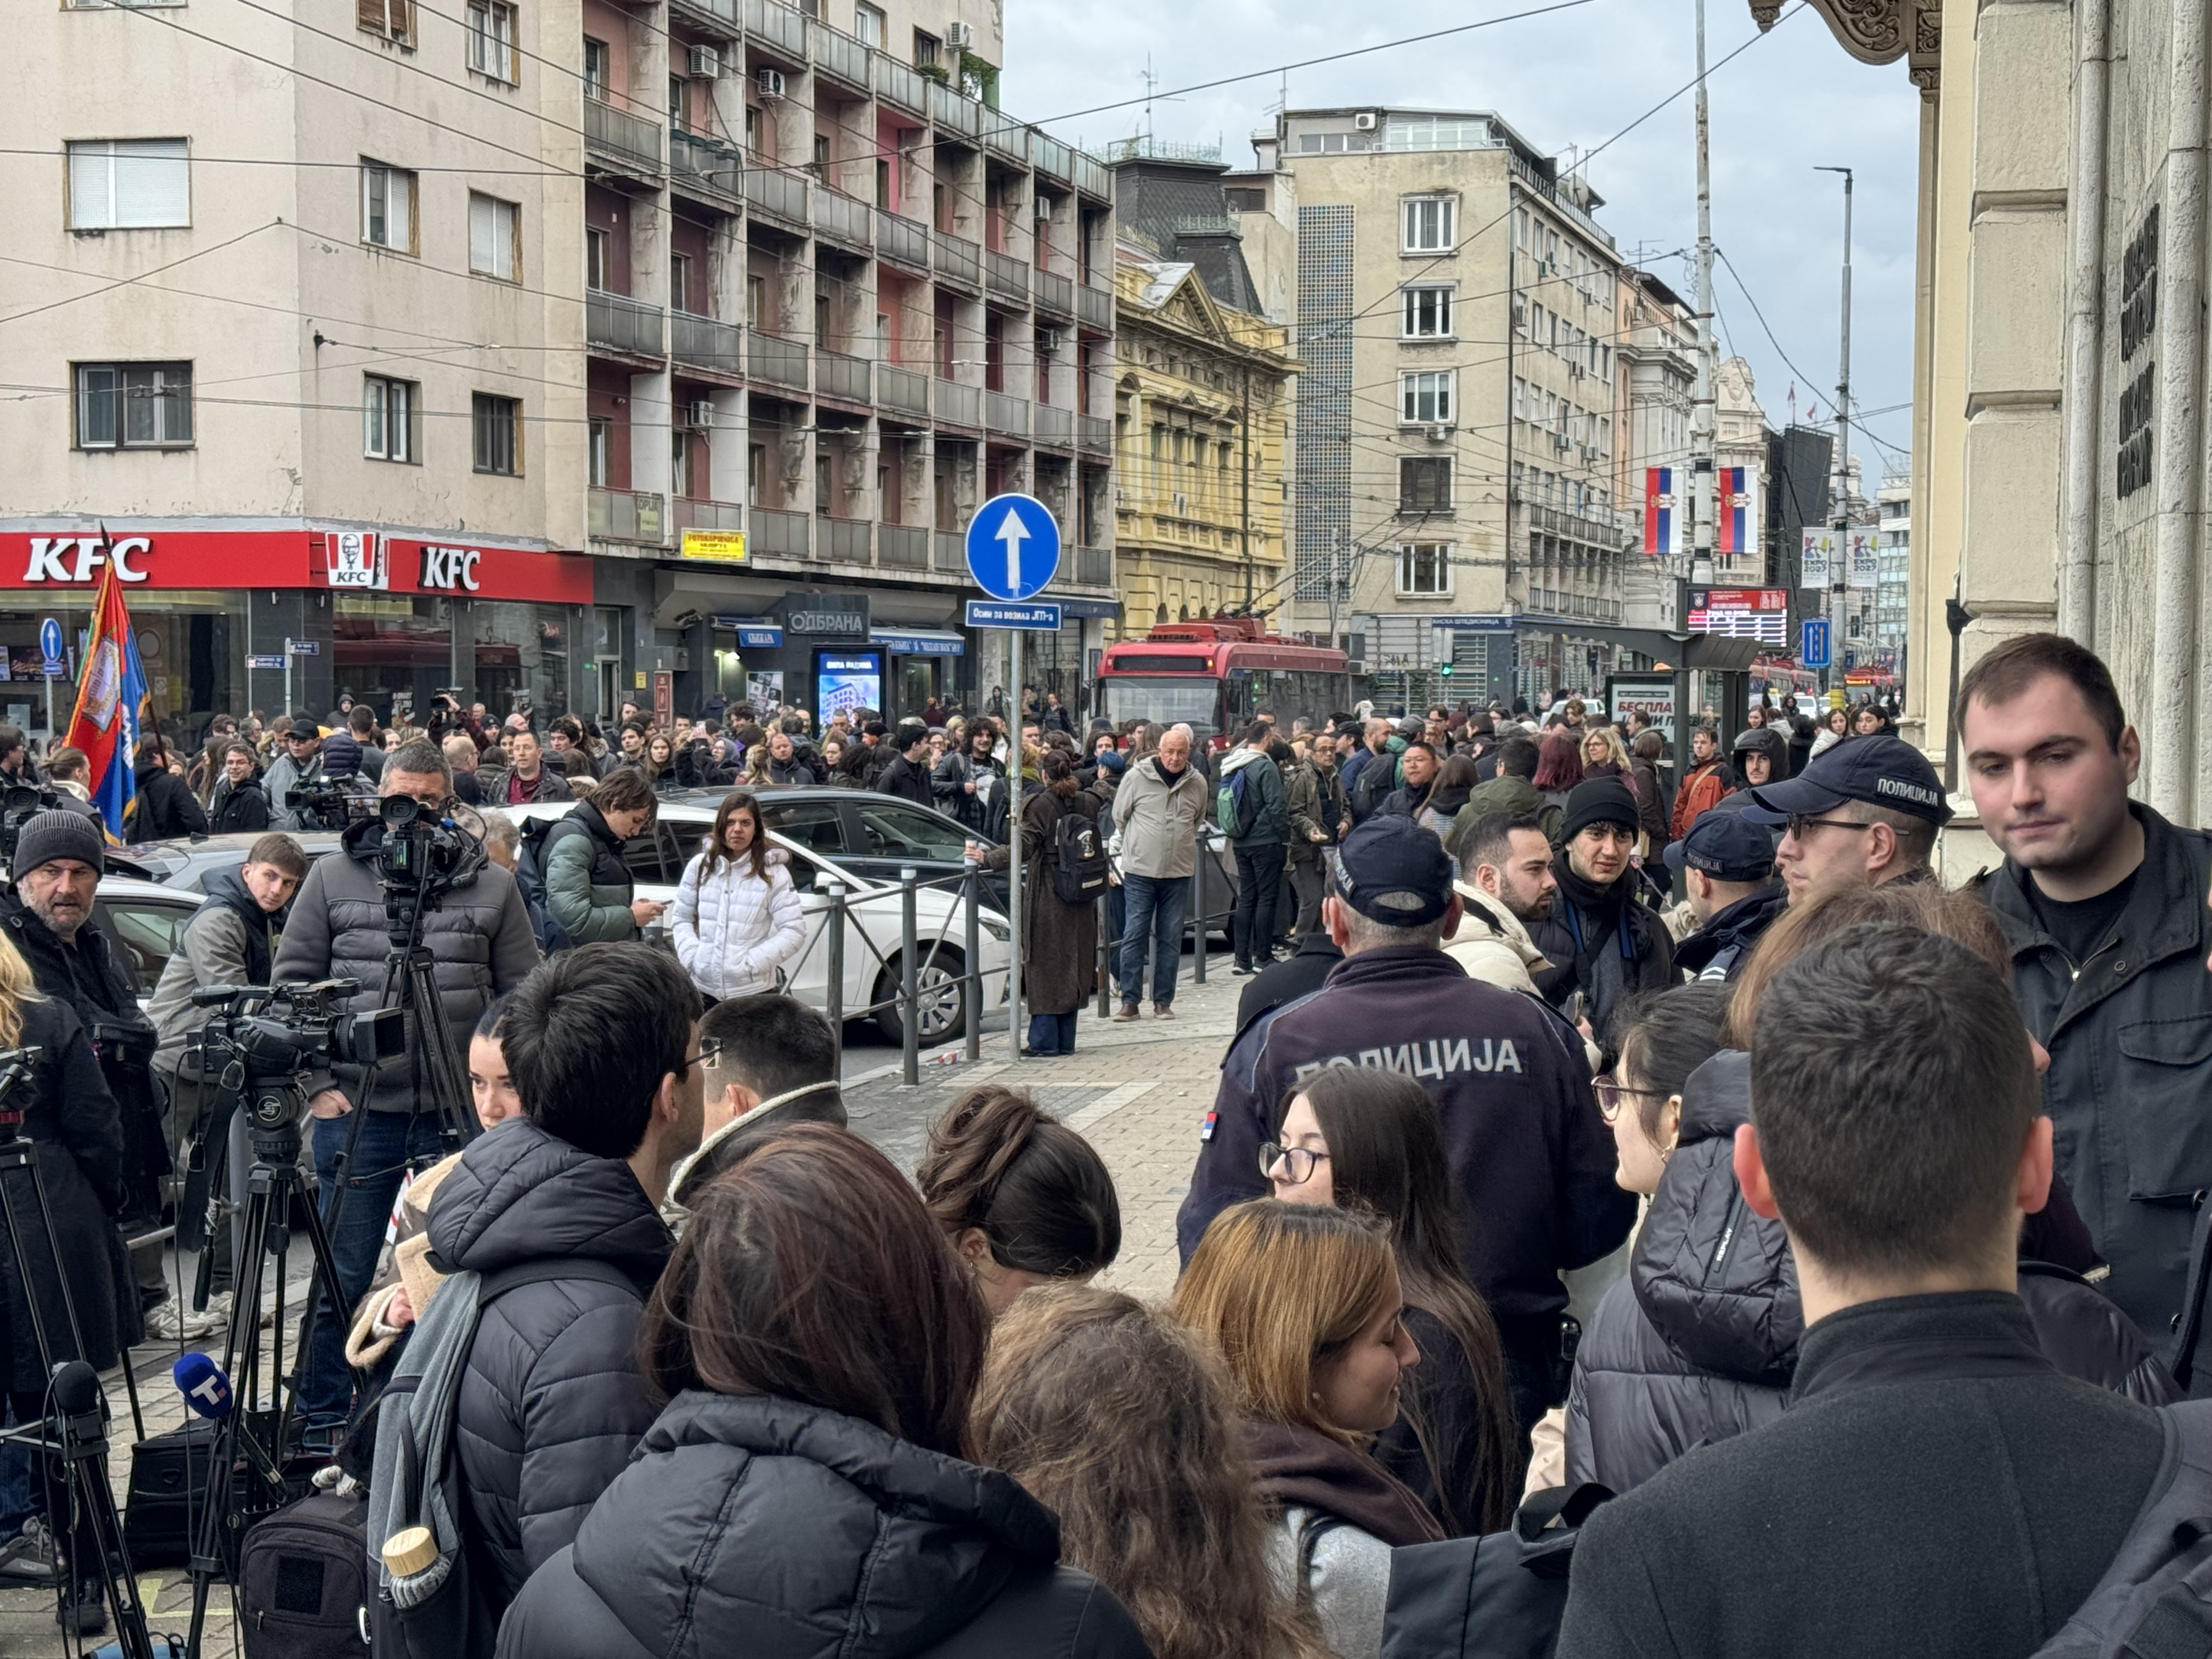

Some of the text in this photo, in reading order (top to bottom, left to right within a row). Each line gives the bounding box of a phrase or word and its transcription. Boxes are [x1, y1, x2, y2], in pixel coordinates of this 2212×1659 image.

[23, 538, 150, 582] KFC
[424, 547, 481, 591] KFC
[336, 572, 366, 583] KFC
[791, 614, 863, 631] ОДБРАНА
[1618, 702, 1674, 713] БЕСПЛА
[1877, 778, 1938, 807] ПОЛИЦИЈА
